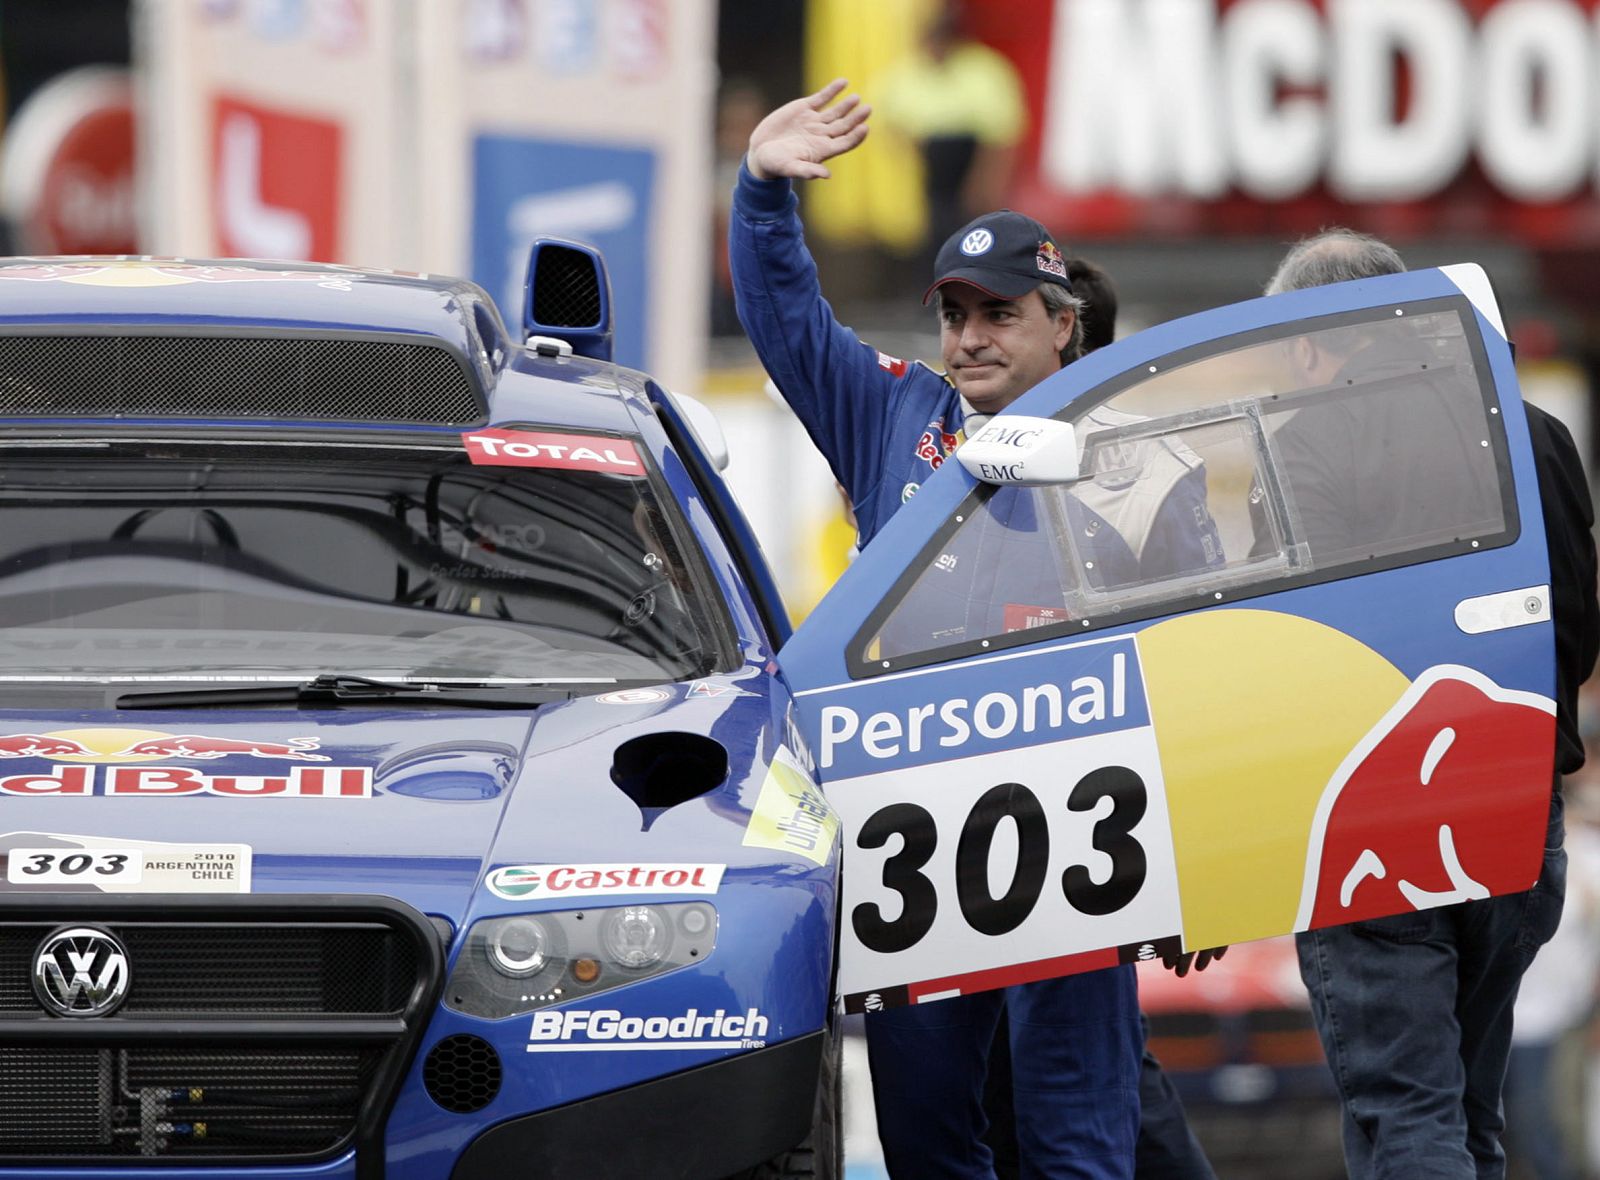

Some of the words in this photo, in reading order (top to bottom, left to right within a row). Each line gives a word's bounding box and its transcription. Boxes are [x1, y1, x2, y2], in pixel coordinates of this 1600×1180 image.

[1040, 0, 1600, 198] McDo
[469, 436, 637, 466] TOTAL
[820, 652, 1126, 768] Personal
[114, 767, 365, 796] Bull
[21, 853, 130, 875] 303
[145, 862, 235, 871] ARGENTINA
[194, 853, 236, 861] 2010
[851, 765, 1148, 953] 303
[192, 870, 235, 880] CHILE
[546, 867, 706, 891] Castrol
[529, 1008, 769, 1040] BFGoodrich
[740, 1039, 766, 1049] Tires
